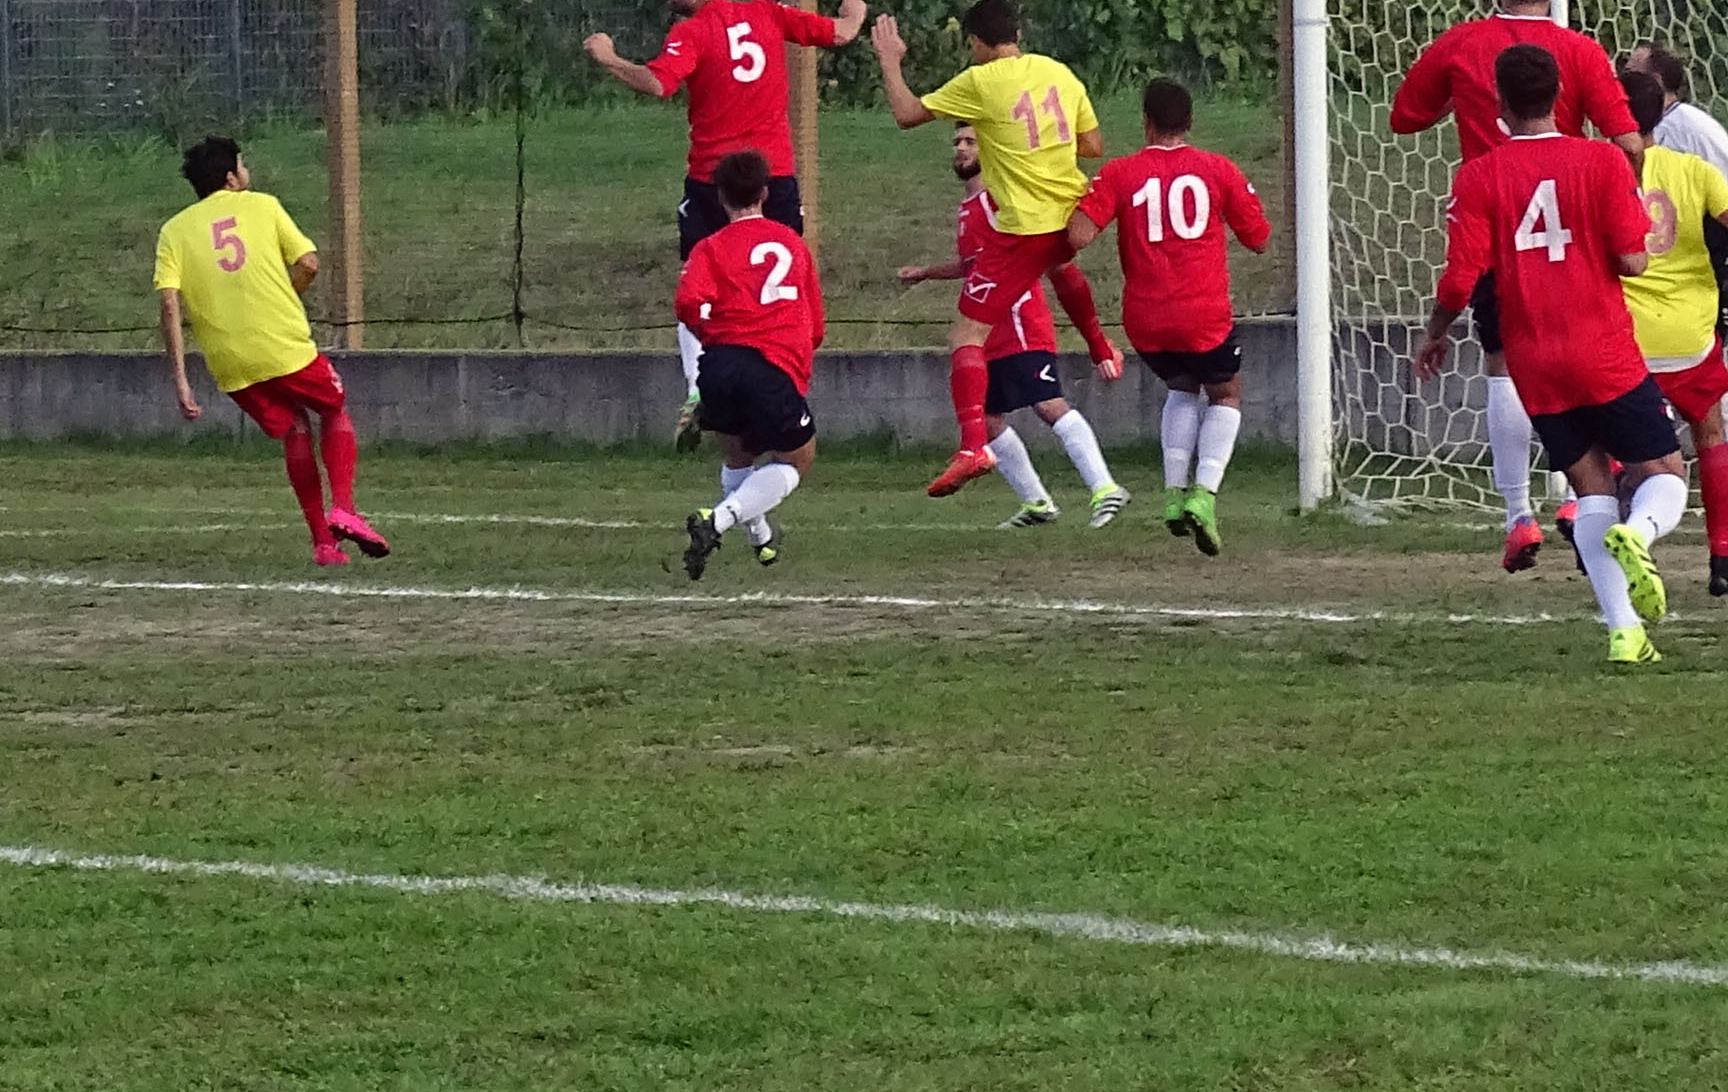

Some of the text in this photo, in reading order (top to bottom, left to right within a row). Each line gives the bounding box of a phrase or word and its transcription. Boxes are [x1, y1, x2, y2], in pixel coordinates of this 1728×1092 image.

[726, 22, 766, 82] 5
[1012, 85, 1070, 150] 11
[1132, 174, 1210, 242] 10
[1514, 179, 1572, 262] 4
[1643, 189, 1678, 255] 9
[212, 216, 246, 272] 5
[749, 241, 798, 305] 2
